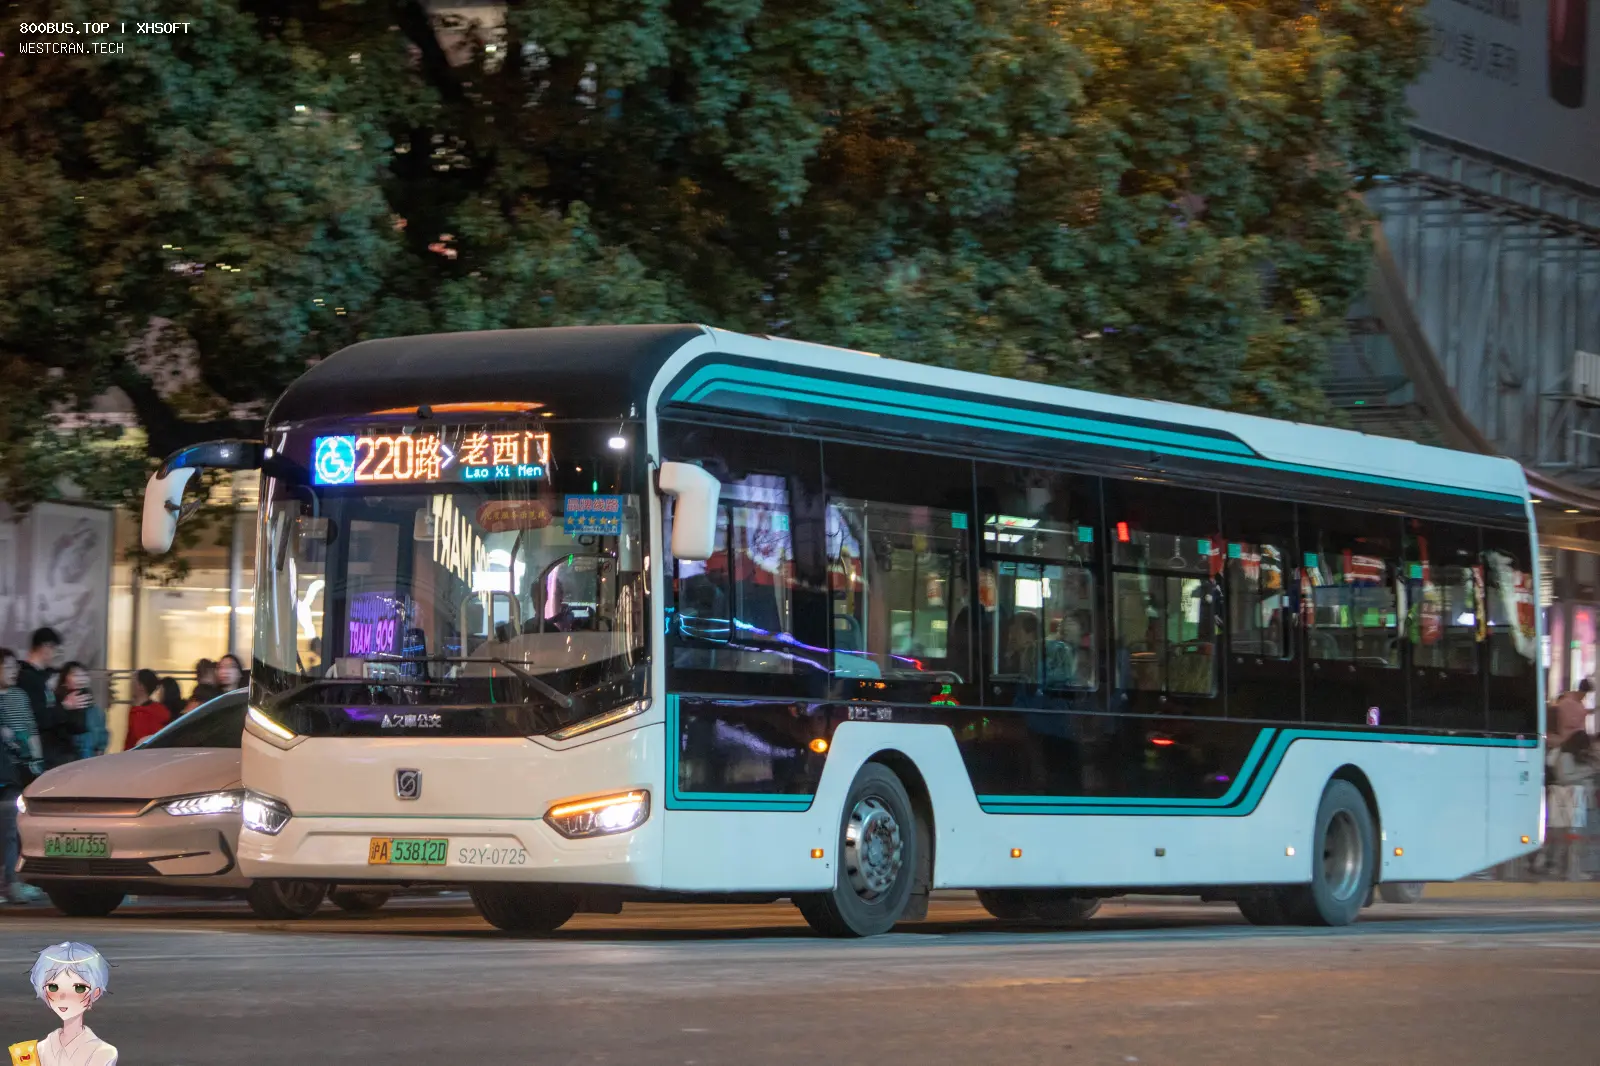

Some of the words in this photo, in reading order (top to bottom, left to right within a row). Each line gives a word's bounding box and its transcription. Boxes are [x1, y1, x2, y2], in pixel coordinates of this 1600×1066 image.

[355, 434, 442, 481] 220路
[460, 431, 550, 465] 老西门
[465, 466, 489, 479] Lao
[495, 465, 510, 477] Xi
[518, 463, 542, 477] Men
[394, 841, 446, 861] 53812D
[458, 848, 526, 865] S2Y-0725
